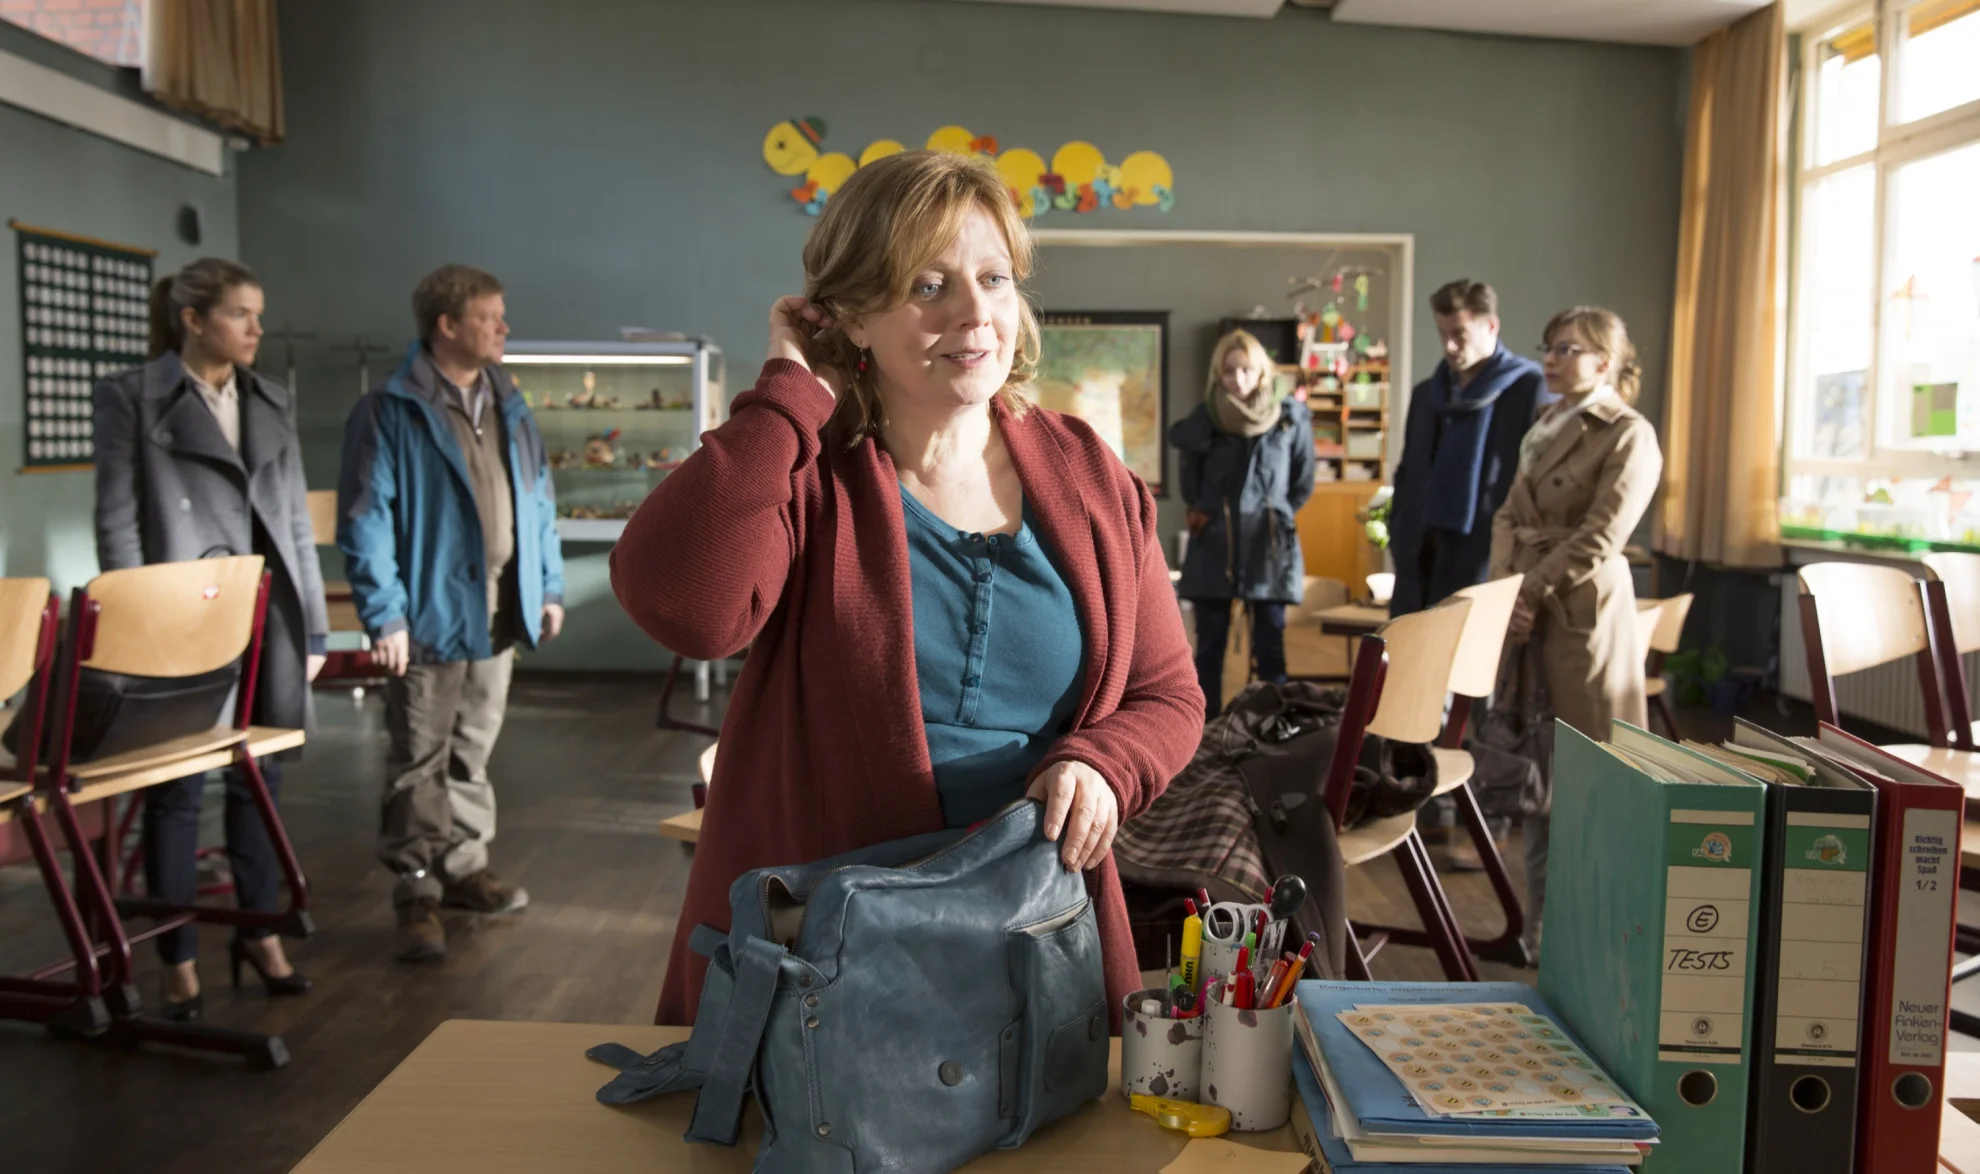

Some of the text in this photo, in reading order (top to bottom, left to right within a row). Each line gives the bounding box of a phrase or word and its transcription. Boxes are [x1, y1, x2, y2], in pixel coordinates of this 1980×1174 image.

[1915, 835, 1943, 845] Richtig
[1909, 845, 1948, 855] schreiben
[1915, 856, 1940, 864] macht
[1917, 865, 1937, 875] Spaß
[1915, 880, 1937, 891] 1/2
[1695, 911, 1713, 928] E
[1668, 949, 1734, 970] TESTS
[1185, 961, 1194, 984] UHU
[1899, 1000, 1940, 1014] Neuer
[1896, 1029, 1939, 1046] Verlag
